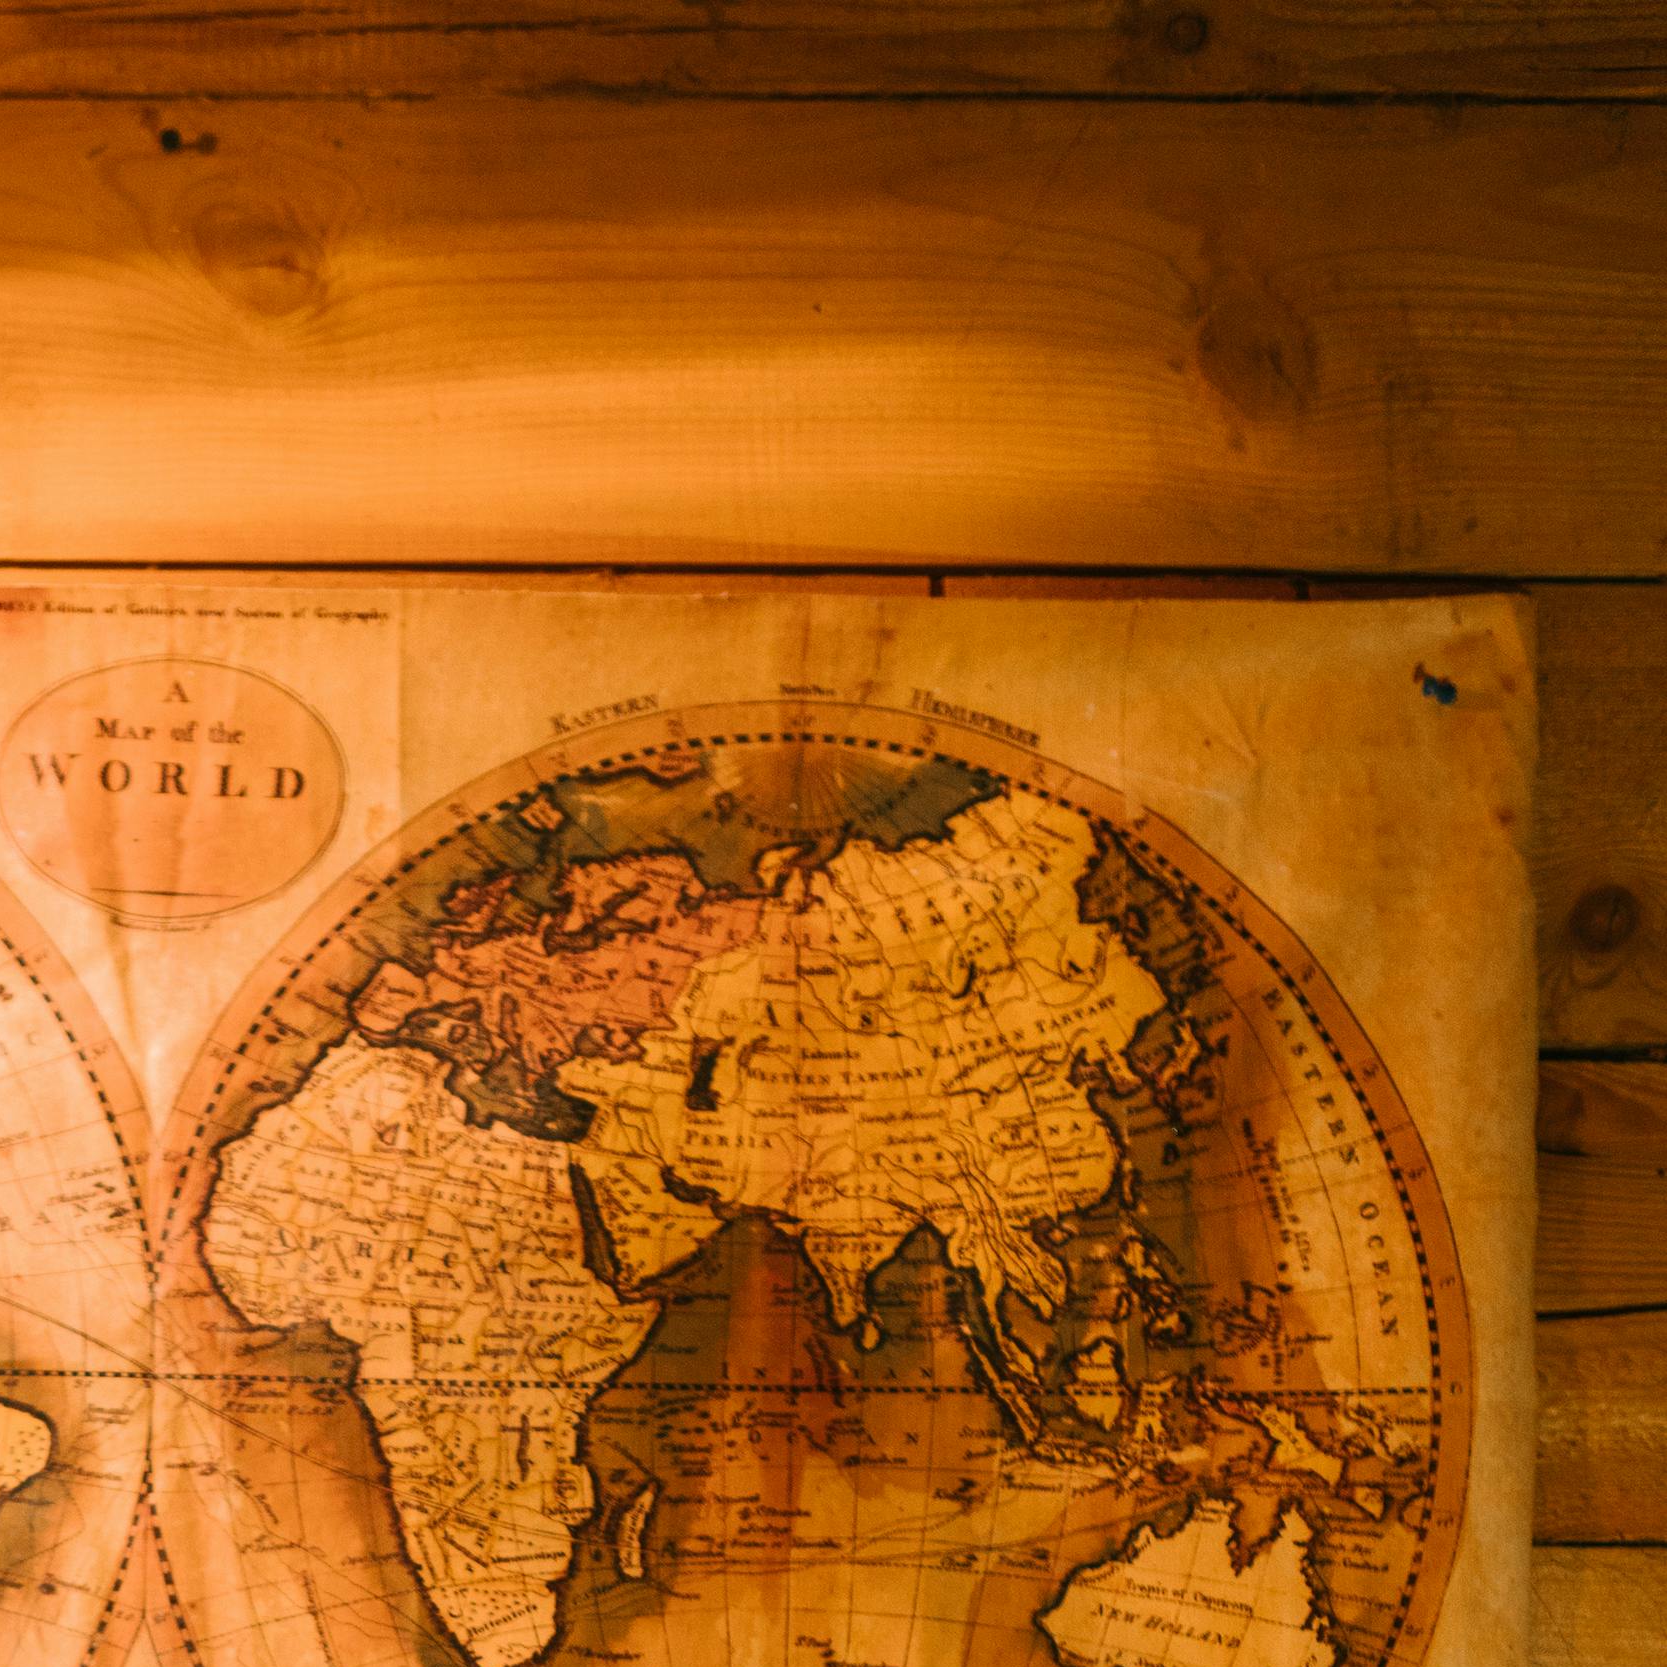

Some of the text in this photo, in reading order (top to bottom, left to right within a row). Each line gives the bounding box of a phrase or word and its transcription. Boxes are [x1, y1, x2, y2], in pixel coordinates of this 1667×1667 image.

[163, 681, 191, 703] A
[170, 720, 200, 742] of
[207, 720, 246, 745] the
[549, 694, 660, 737] EASTERN
[28, 750, 309, 800] WORLD
[685, 1131, 773, 1149] PERSIA
[274, 1228, 511, 1276] AFRICA
[1358, 1200, 1399, 1338] OCEAN
[1143, 1615, 1242, 1649] HOLLAND
